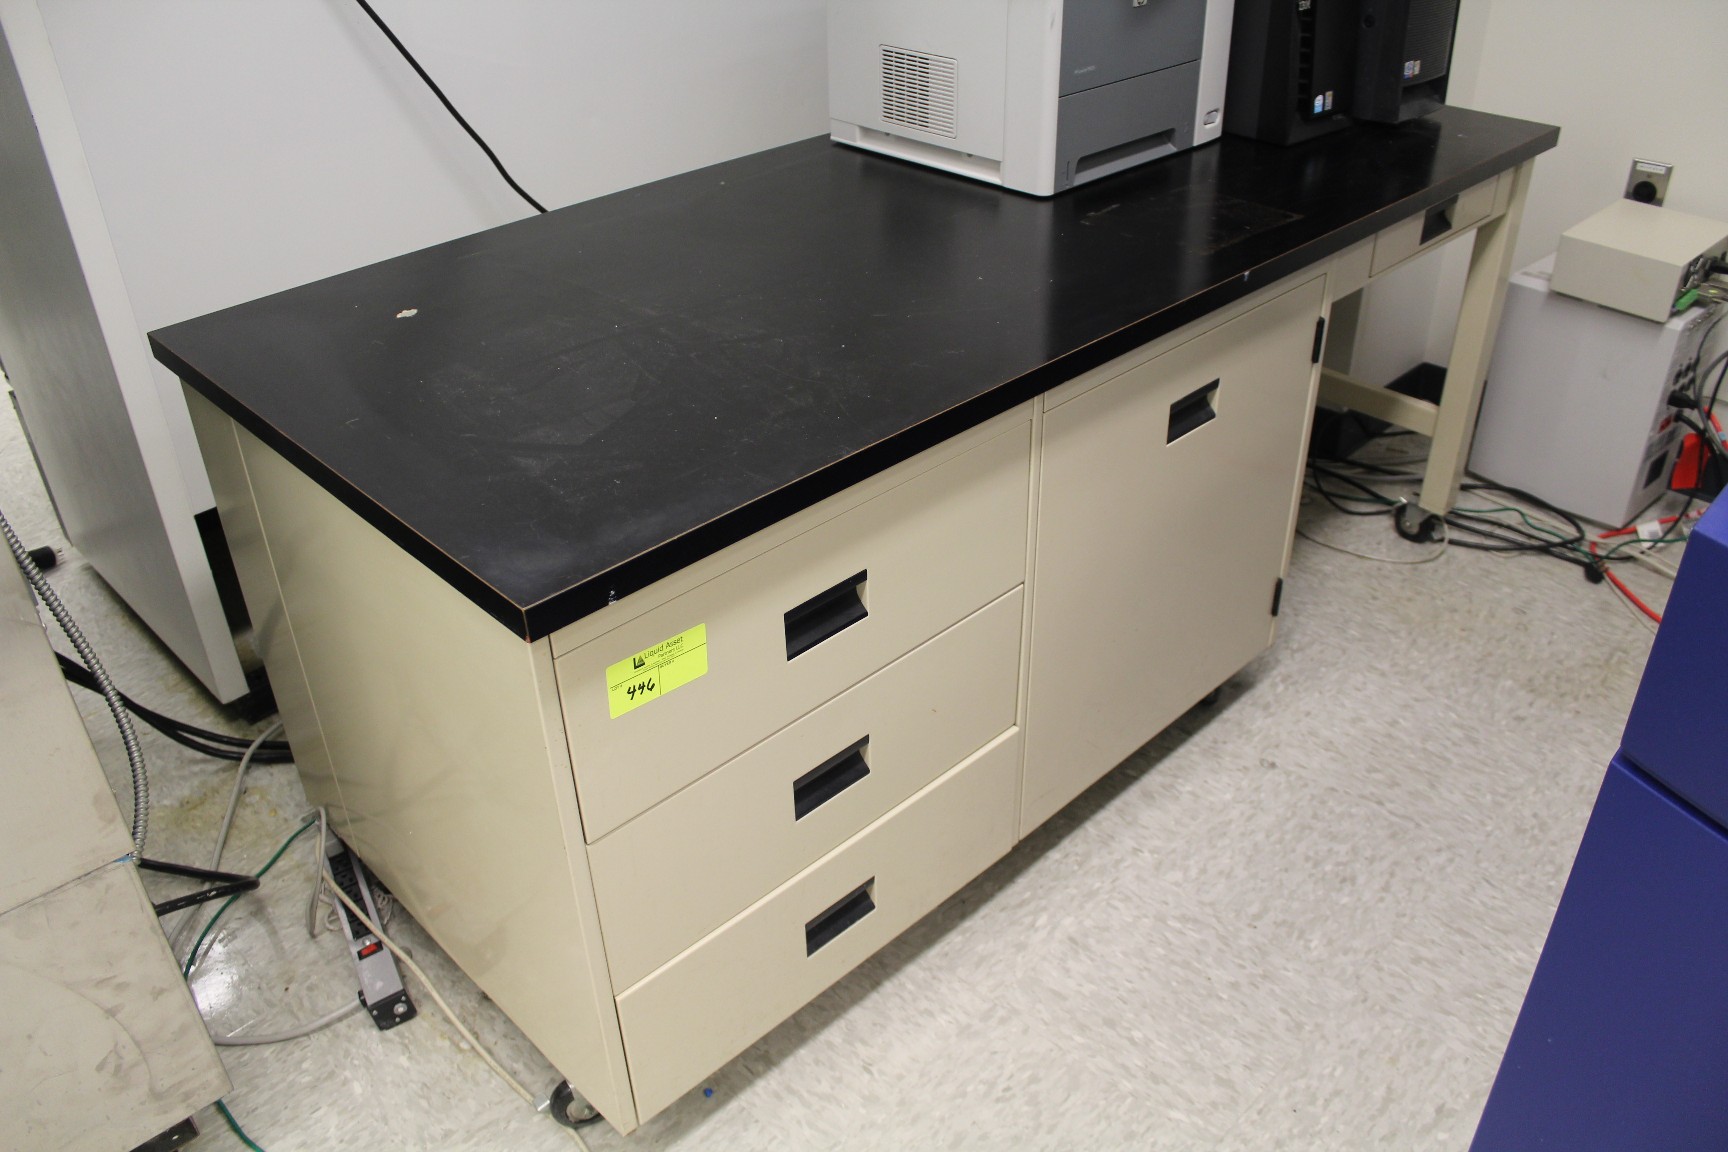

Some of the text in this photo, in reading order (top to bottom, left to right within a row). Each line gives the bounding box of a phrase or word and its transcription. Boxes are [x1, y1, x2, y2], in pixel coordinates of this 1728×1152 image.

[644, 644, 663, 659] Liquid
[665, 636, 683, 649] Asset
[626, 677, 655, 700] 446
